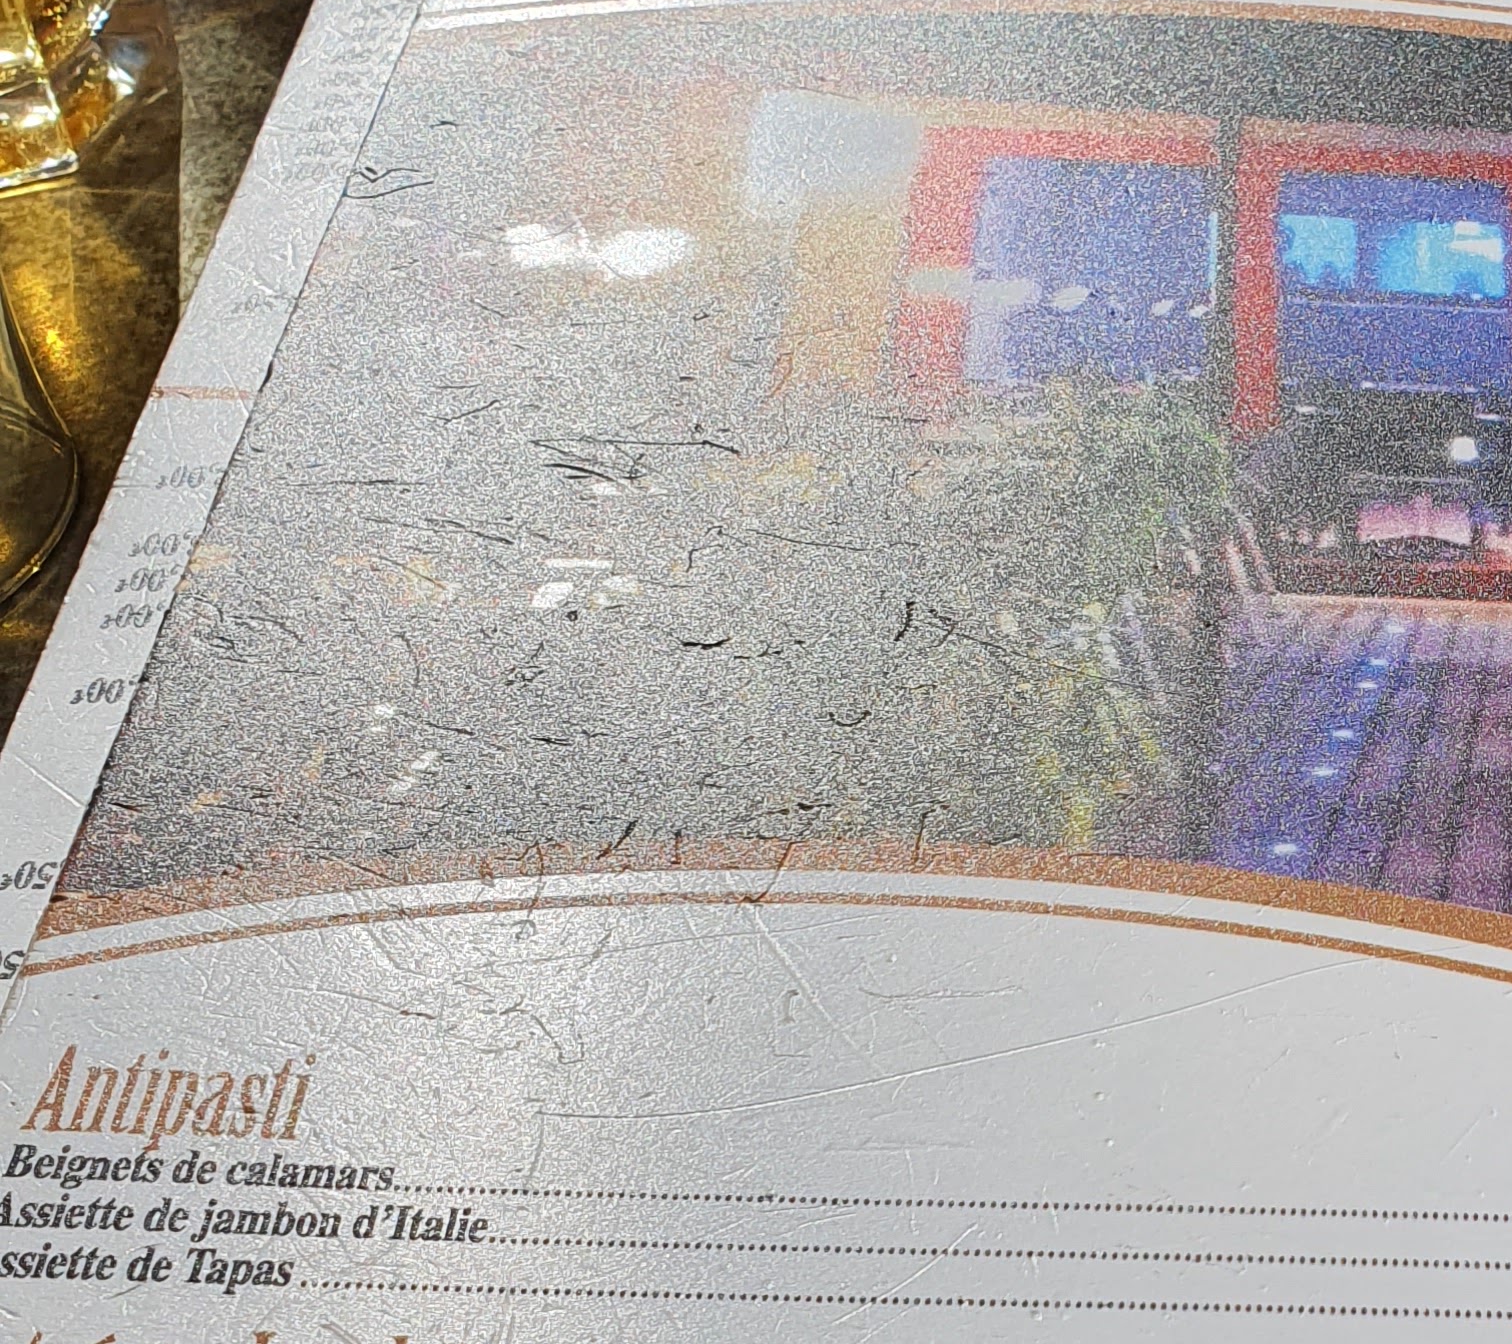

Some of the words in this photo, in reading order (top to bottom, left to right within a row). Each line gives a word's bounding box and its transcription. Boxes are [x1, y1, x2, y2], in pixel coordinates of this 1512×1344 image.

[21, 1044, 317, 1150] Antipasti
[3, 1145, 164, 1189] Beignets
[172, 1150, 217, 1184] de
[226, 1154, 394, 1191] calamars
[144, 1198, 189, 1232] de
[192, 1201, 341, 1244] jambon
[127, 1246, 172, 1282] de
[186, 1248, 294, 1295] Tapas
